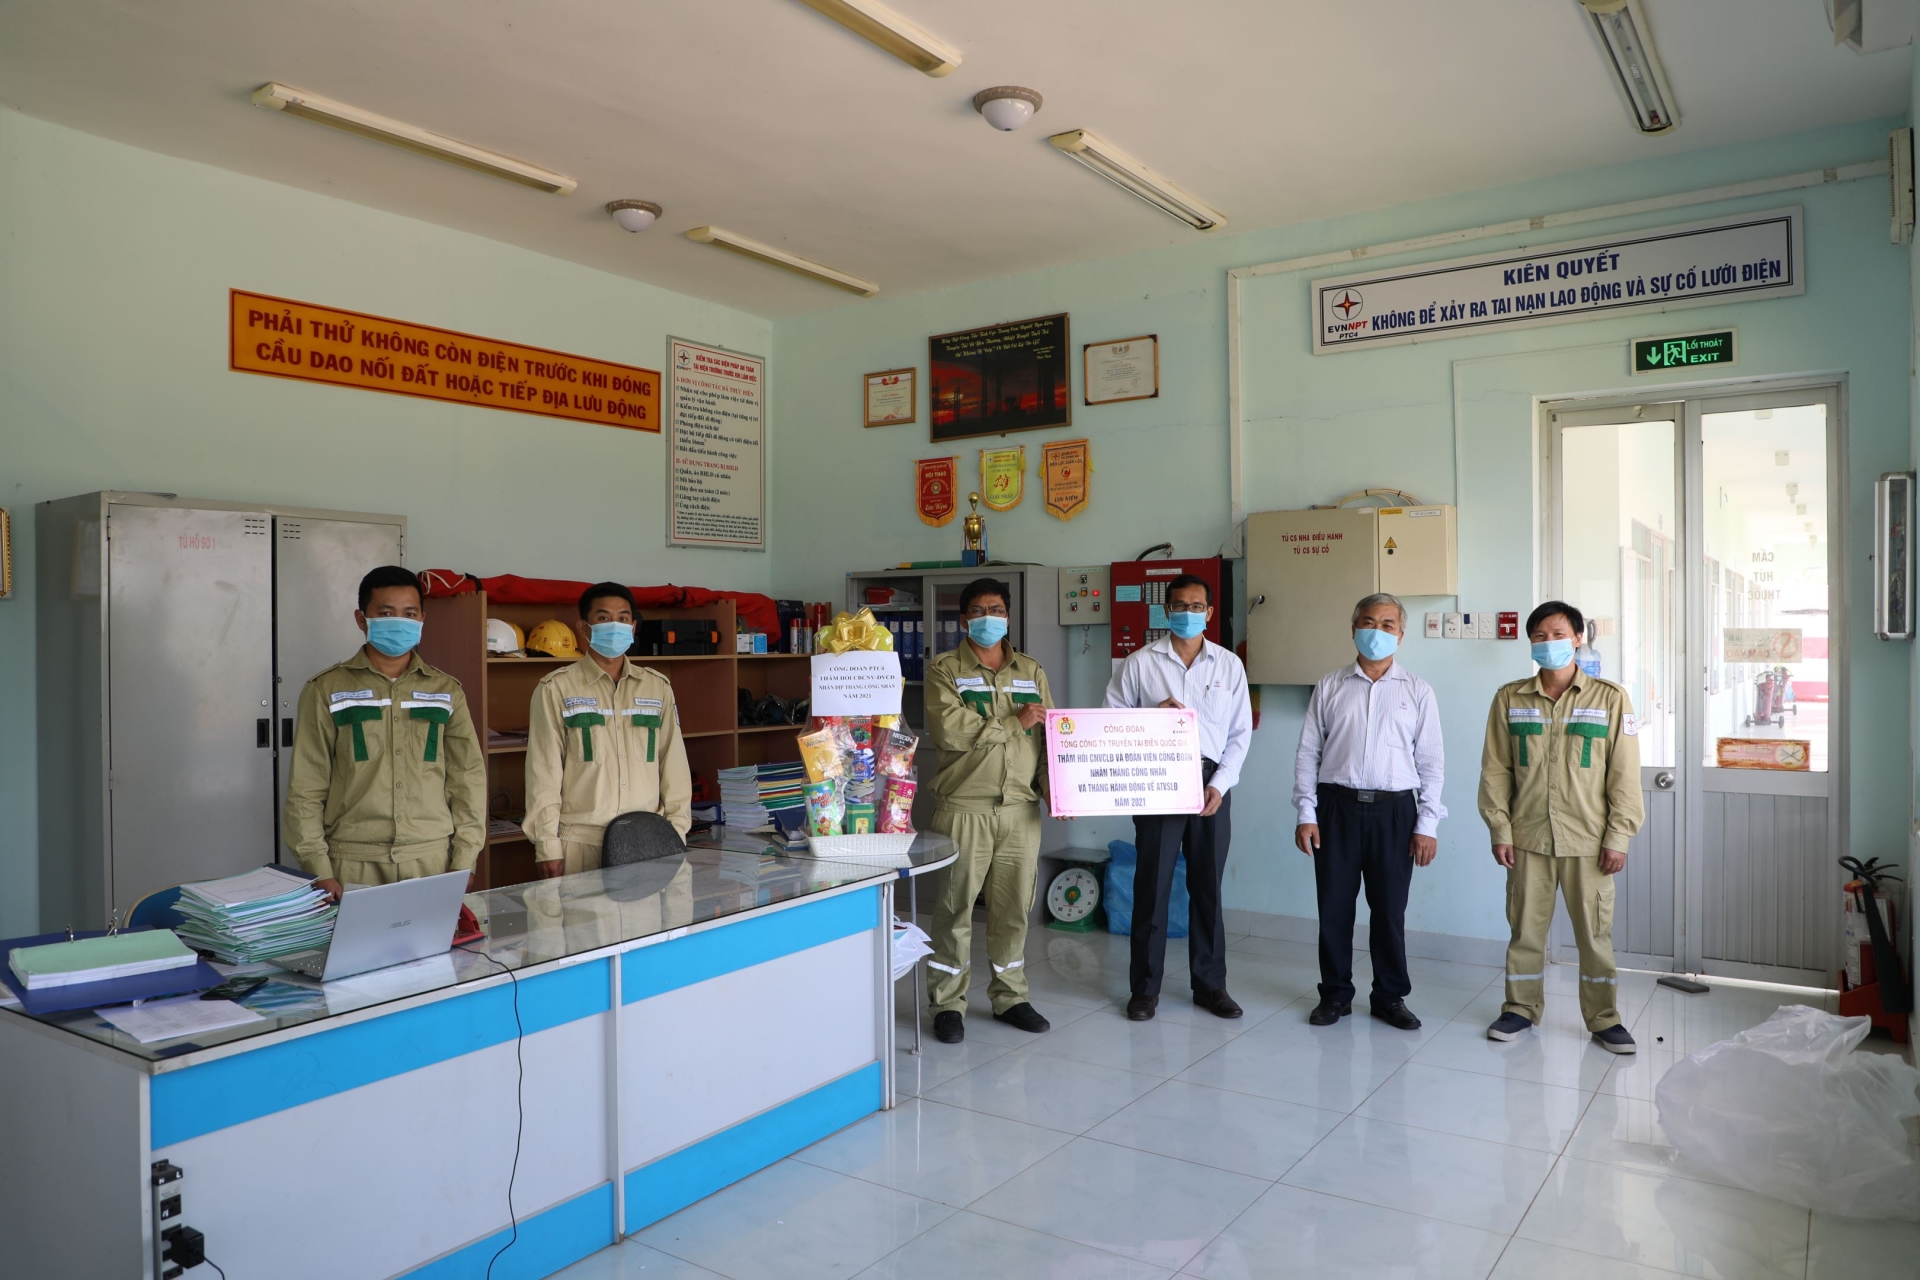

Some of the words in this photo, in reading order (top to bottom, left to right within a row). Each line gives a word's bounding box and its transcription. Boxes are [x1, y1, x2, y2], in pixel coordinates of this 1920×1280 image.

[1503, 263, 1550, 286] KIÊN
[1557, 250, 1620, 280] QUYẾT
[1372, 310, 1416, 331] KHÔNG
[1419, 301, 1437, 325] ĐỂ
[1440, 300, 1466, 322] XẢY
[1470, 301, 1488, 318] RA
[1491, 298, 1511, 315] TAI
[1515, 292, 1546, 314] NẠN
[1550, 288, 1576, 308] LAO
[1580, 282, 1622, 305] ĐỘNG
[1626, 276, 1646, 297] VÀ
[1650, 272, 1672, 296] SỰ
[1675, 265, 1697, 291] CỐ
[1701, 263, 1737, 288] LƯỚI
[1741, 258, 1781, 283] ĐIỆN
[1327, 320, 1368, 334] EVNNPT
[1338, 331, 1359, 340] PTC4
[1686, 339, 1698, 350] LỐI
[1699, 338, 1723, 349] THOÁT
[249, 309, 302, 335] PHẢI
[309, 320, 355, 343] THỬ
[361, 329, 429, 357] KHÔNG
[435, 342, 471, 365] CÒN
[478, 351, 519, 373] ĐIỆN
[524, 360, 577, 383] TRƯỚC
[582, 370, 607, 388] KHI
[612, 374, 651, 397] ĐÓNG
[1690, 352, 1719, 363] EXIT
[256, 338, 301, 365] CẦU
[310, 351, 353, 373] DAO
[360, 357, 394, 380] NỐI
[401, 363, 439, 386] ĐẤT
[446, 373, 493, 398] HOẶC
[499, 380, 538, 402] TIẾP
[542, 389, 569, 409] ĐỊA
[574, 394, 602, 412] LƯU
[607, 399, 646, 420] ĐỘNG
[1103, 724, 1123, 733] CÔNG
[1126, 724, 1145, 733] ĐOÀN
[1060, 737, 1078, 749] TỔNG
[1079, 738, 1097, 748] CÔNG
[1099, 740, 1106, 748] TY
[1160, 736, 1177, 747] QUỐC
[1057, 753, 1076, 764] THĂM
[1077, 751, 1088, 763] HỎI
[1115, 752, 1124, 762] VÀ
[1124, 751, 1141, 762] ĐOÀN
[1142, 751, 1157, 762] VIÊN
[1158, 751, 1175, 761] CÔNG
[1176, 751, 1193, 761] ĐOÀN
[1110, 767, 1130, 777] THÁNG
[1131, 767, 1148, 777] CÔNG
[1078, 782, 1087, 793] VÀ
[1088, 781, 1109, 792] THÁNG
[1110, 781, 1128, 792] HÀNH
[1128, 781, 1146, 793] ĐỘNG
[1156, 782, 1178, 791] ATVSLĐ
[1114, 797, 1129, 807] NĂM
[1131, 797, 1146, 807] 2021
[388, 919, 412, 929] ASUS
